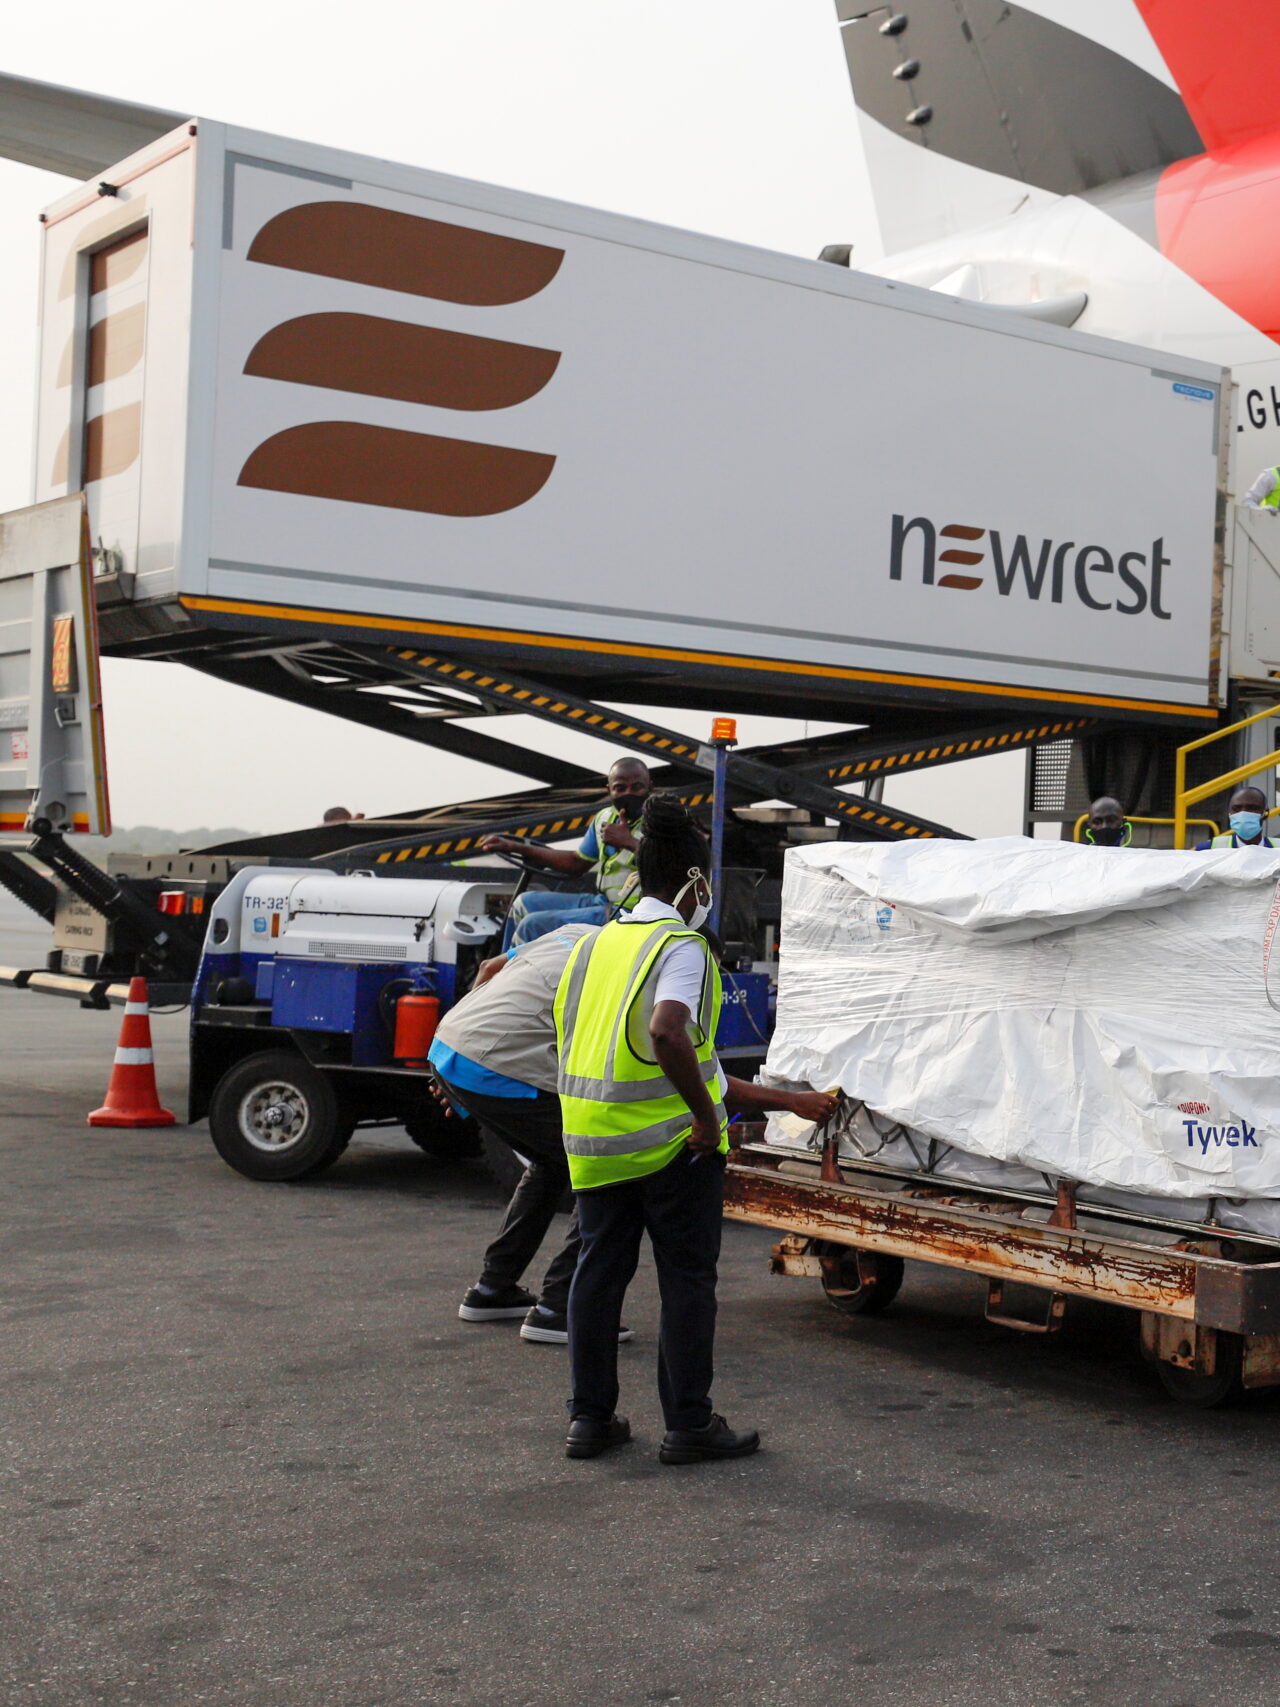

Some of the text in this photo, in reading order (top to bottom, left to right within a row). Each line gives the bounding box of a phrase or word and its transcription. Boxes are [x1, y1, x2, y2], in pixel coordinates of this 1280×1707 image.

[721, 990, 747, 1005] R-32
[1179, 1101, 1209, 1115] DUPONT
[1182, 1120, 1258, 1155] Tyvek
